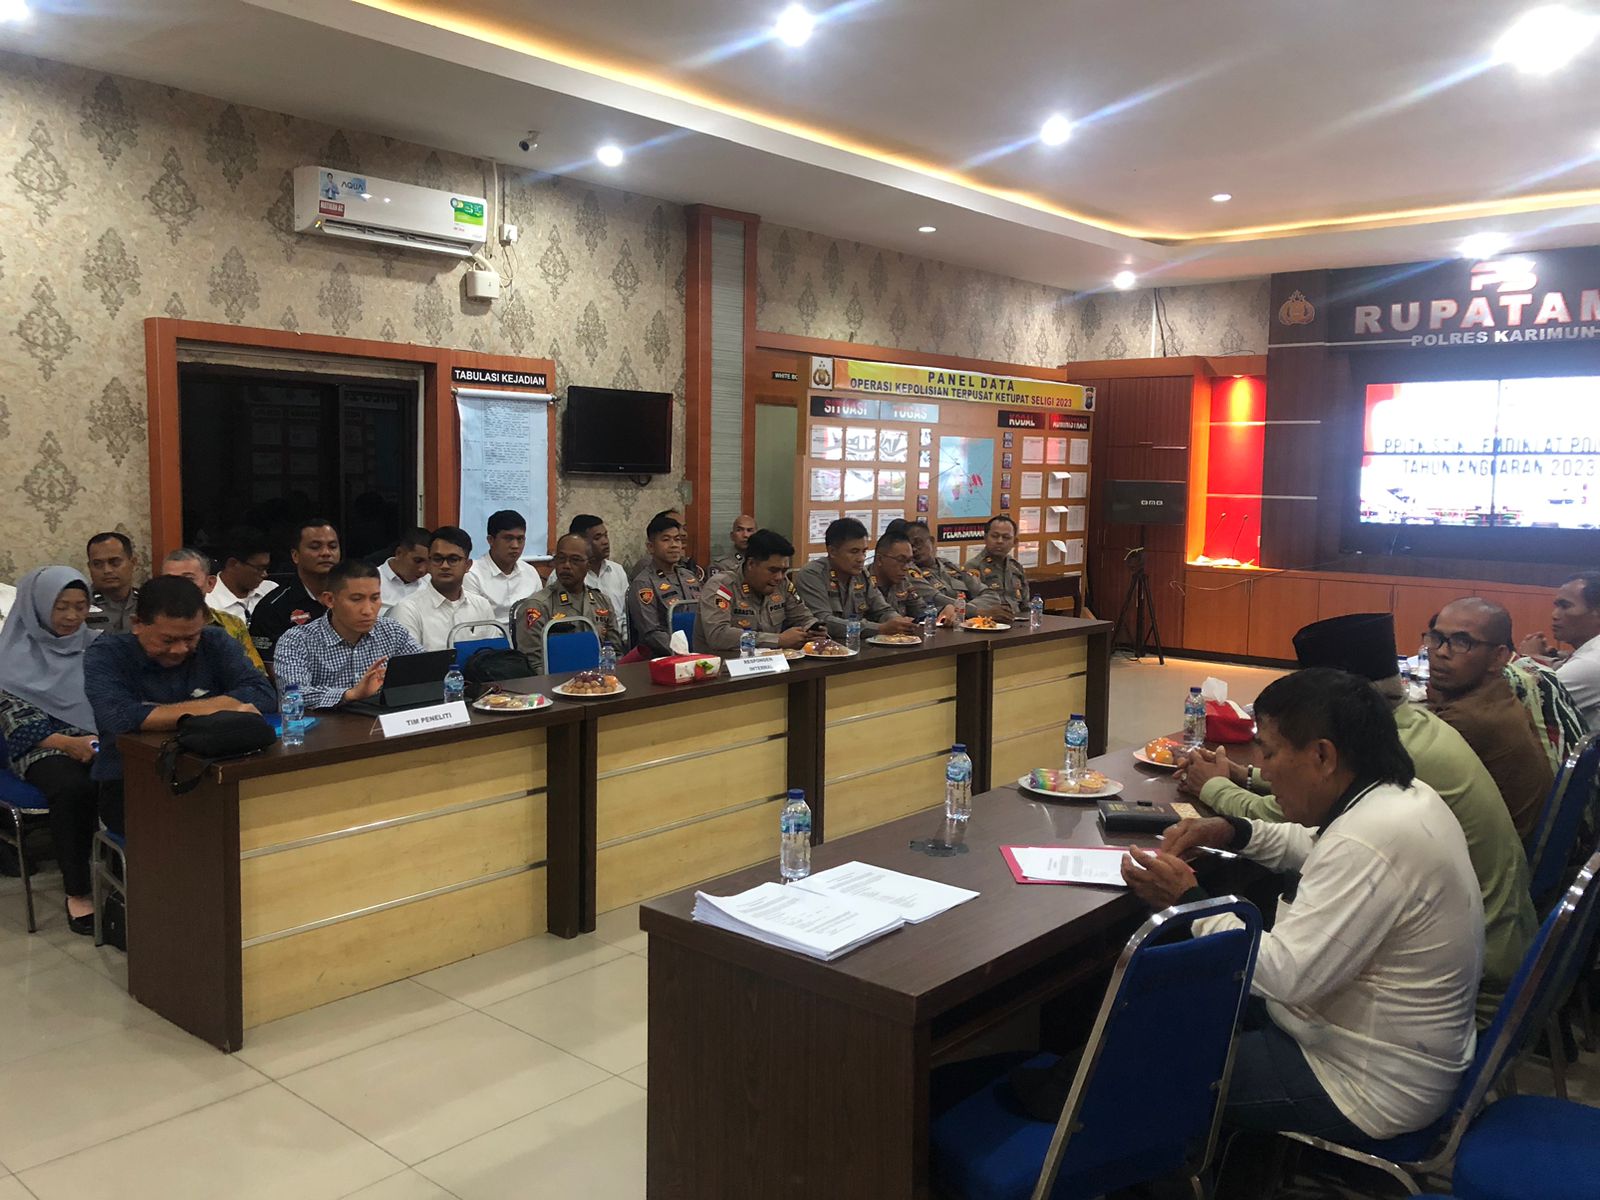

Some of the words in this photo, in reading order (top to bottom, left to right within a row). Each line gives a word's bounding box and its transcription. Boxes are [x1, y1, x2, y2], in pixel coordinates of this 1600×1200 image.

[1411, 330, 1489, 347] POLRES
[1494, 326, 1596, 344] KARIMUN
[454, 370, 500, 382] TABULASI
[501, 373, 545, 386] KEJADIAN
[928, 371, 975, 387] PANEL
[980, 377, 1015, 392] DATA
[850, 378, 893, 392] OPERASI
[895, 383, 949, 396] KEPOLISIAN
[951, 388, 993, 401] TERPUSAT
[995, 391, 1030, 404] KETUPAT
[1031, 395, 1055, 406] SELIGI
[1055, 398, 1072, 408] 2023
[824, 400, 868, 416] SITUASI
[892, 405, 928, 420] TUGAS
[1404, 459, 1451, 476] TAHUN
[1458, 459, 1543, 476] ANGARAN
[1551, 459, 1595, 476] 2023
[421, 712, 452, 724] PENELITI
